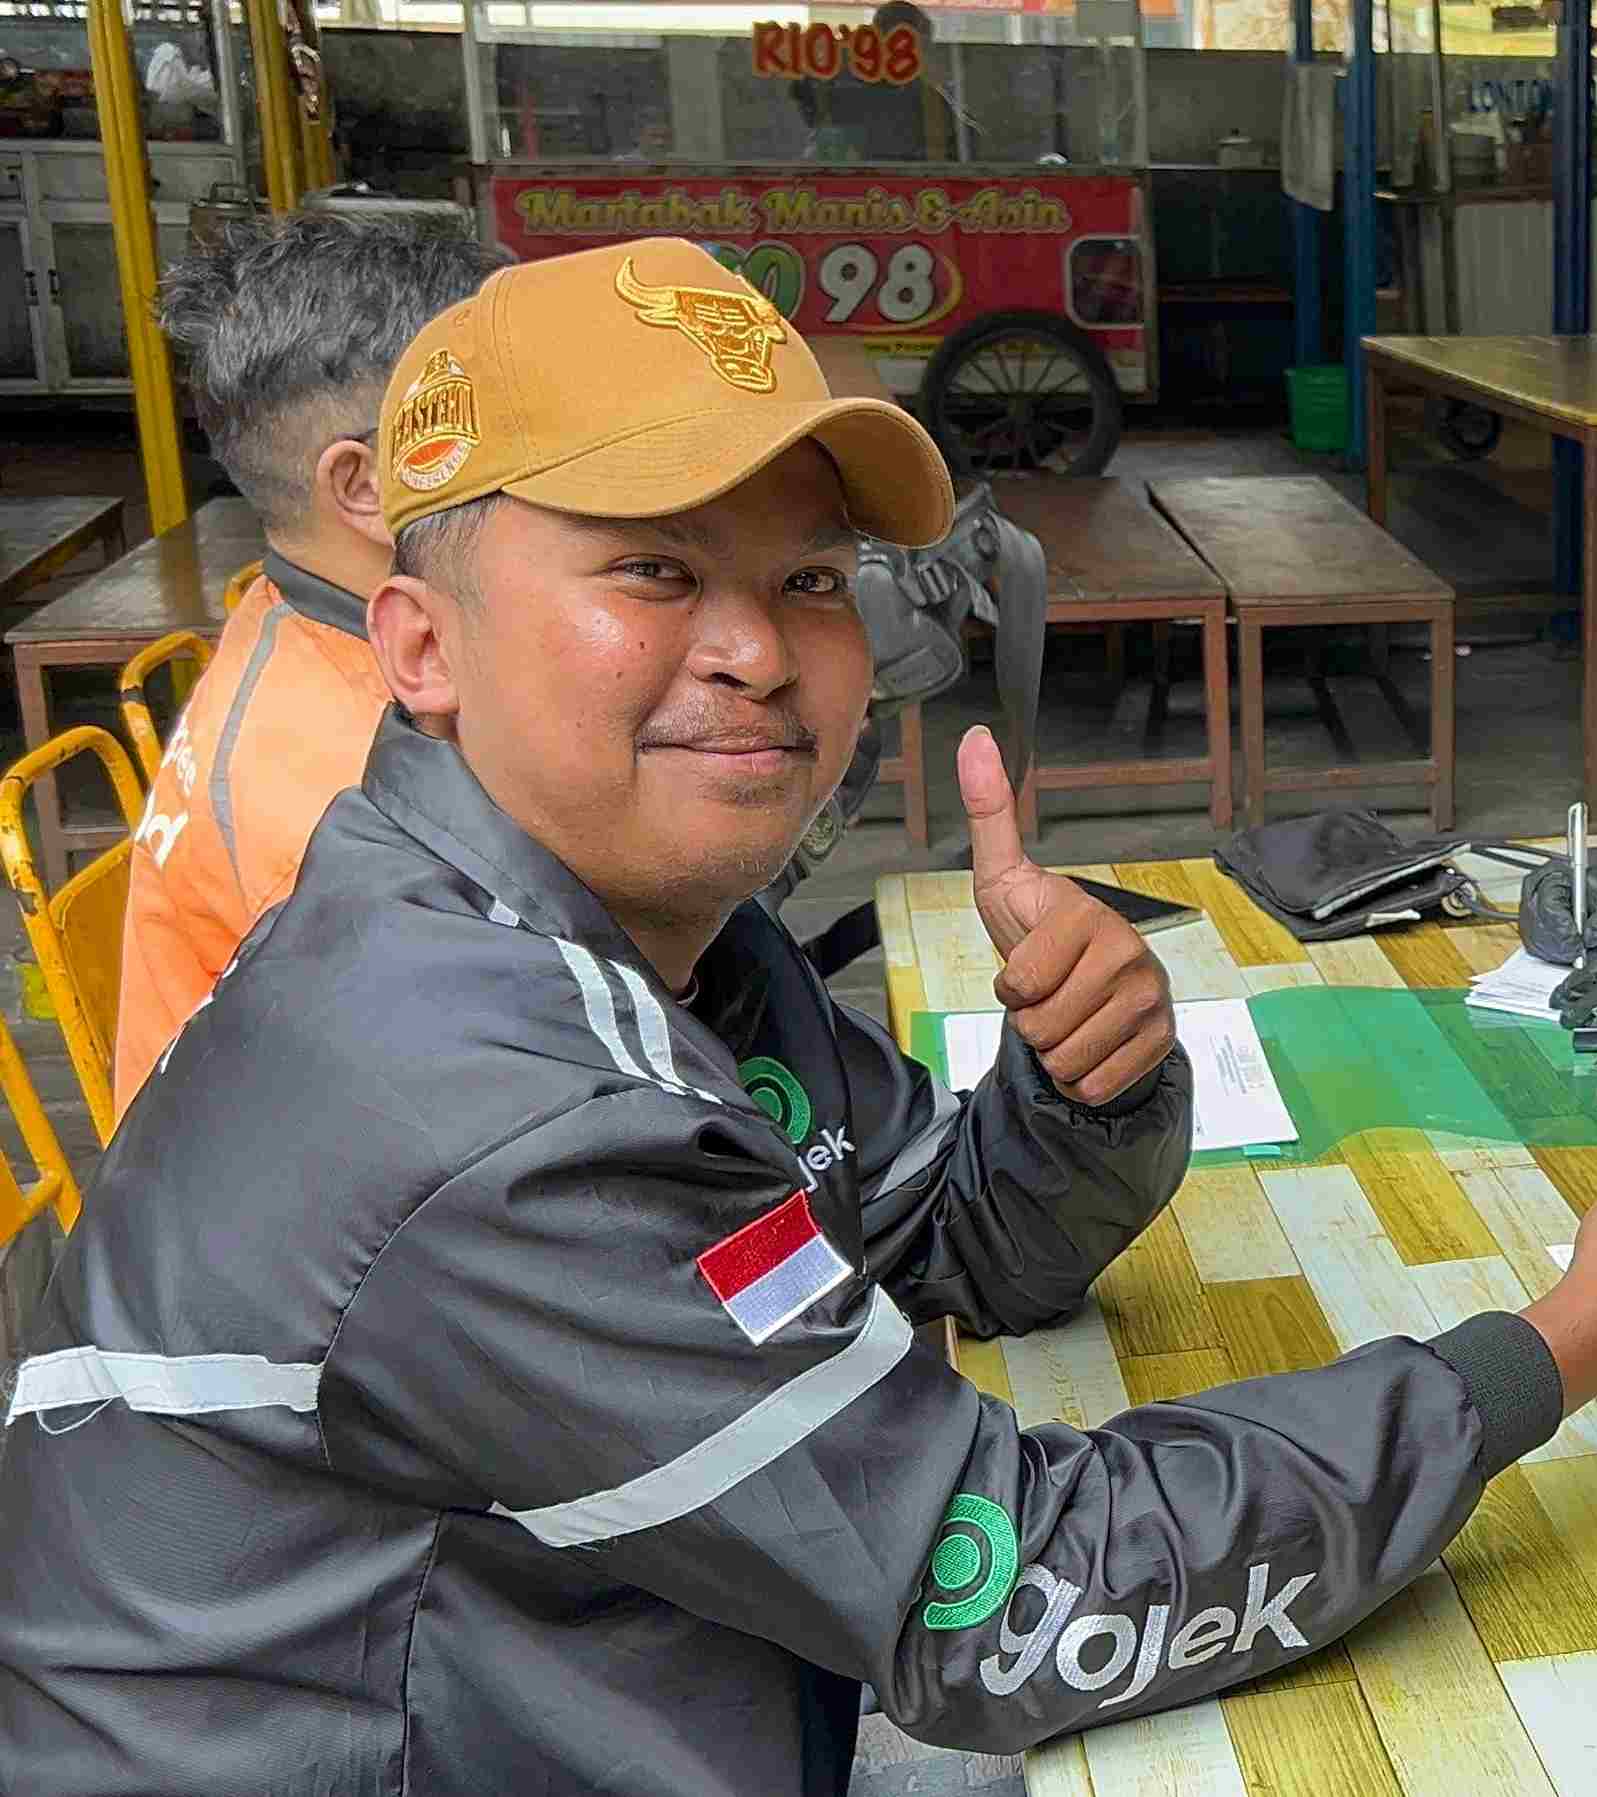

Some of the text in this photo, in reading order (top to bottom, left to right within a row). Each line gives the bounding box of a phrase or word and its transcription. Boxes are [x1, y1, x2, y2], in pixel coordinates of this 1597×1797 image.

[518, 187, 758, 234] Martabak
[760, 187, 911, 234] Manis
[820, 243, 938, 324] 98
[980, 1562, 1318, 1710] gojek
